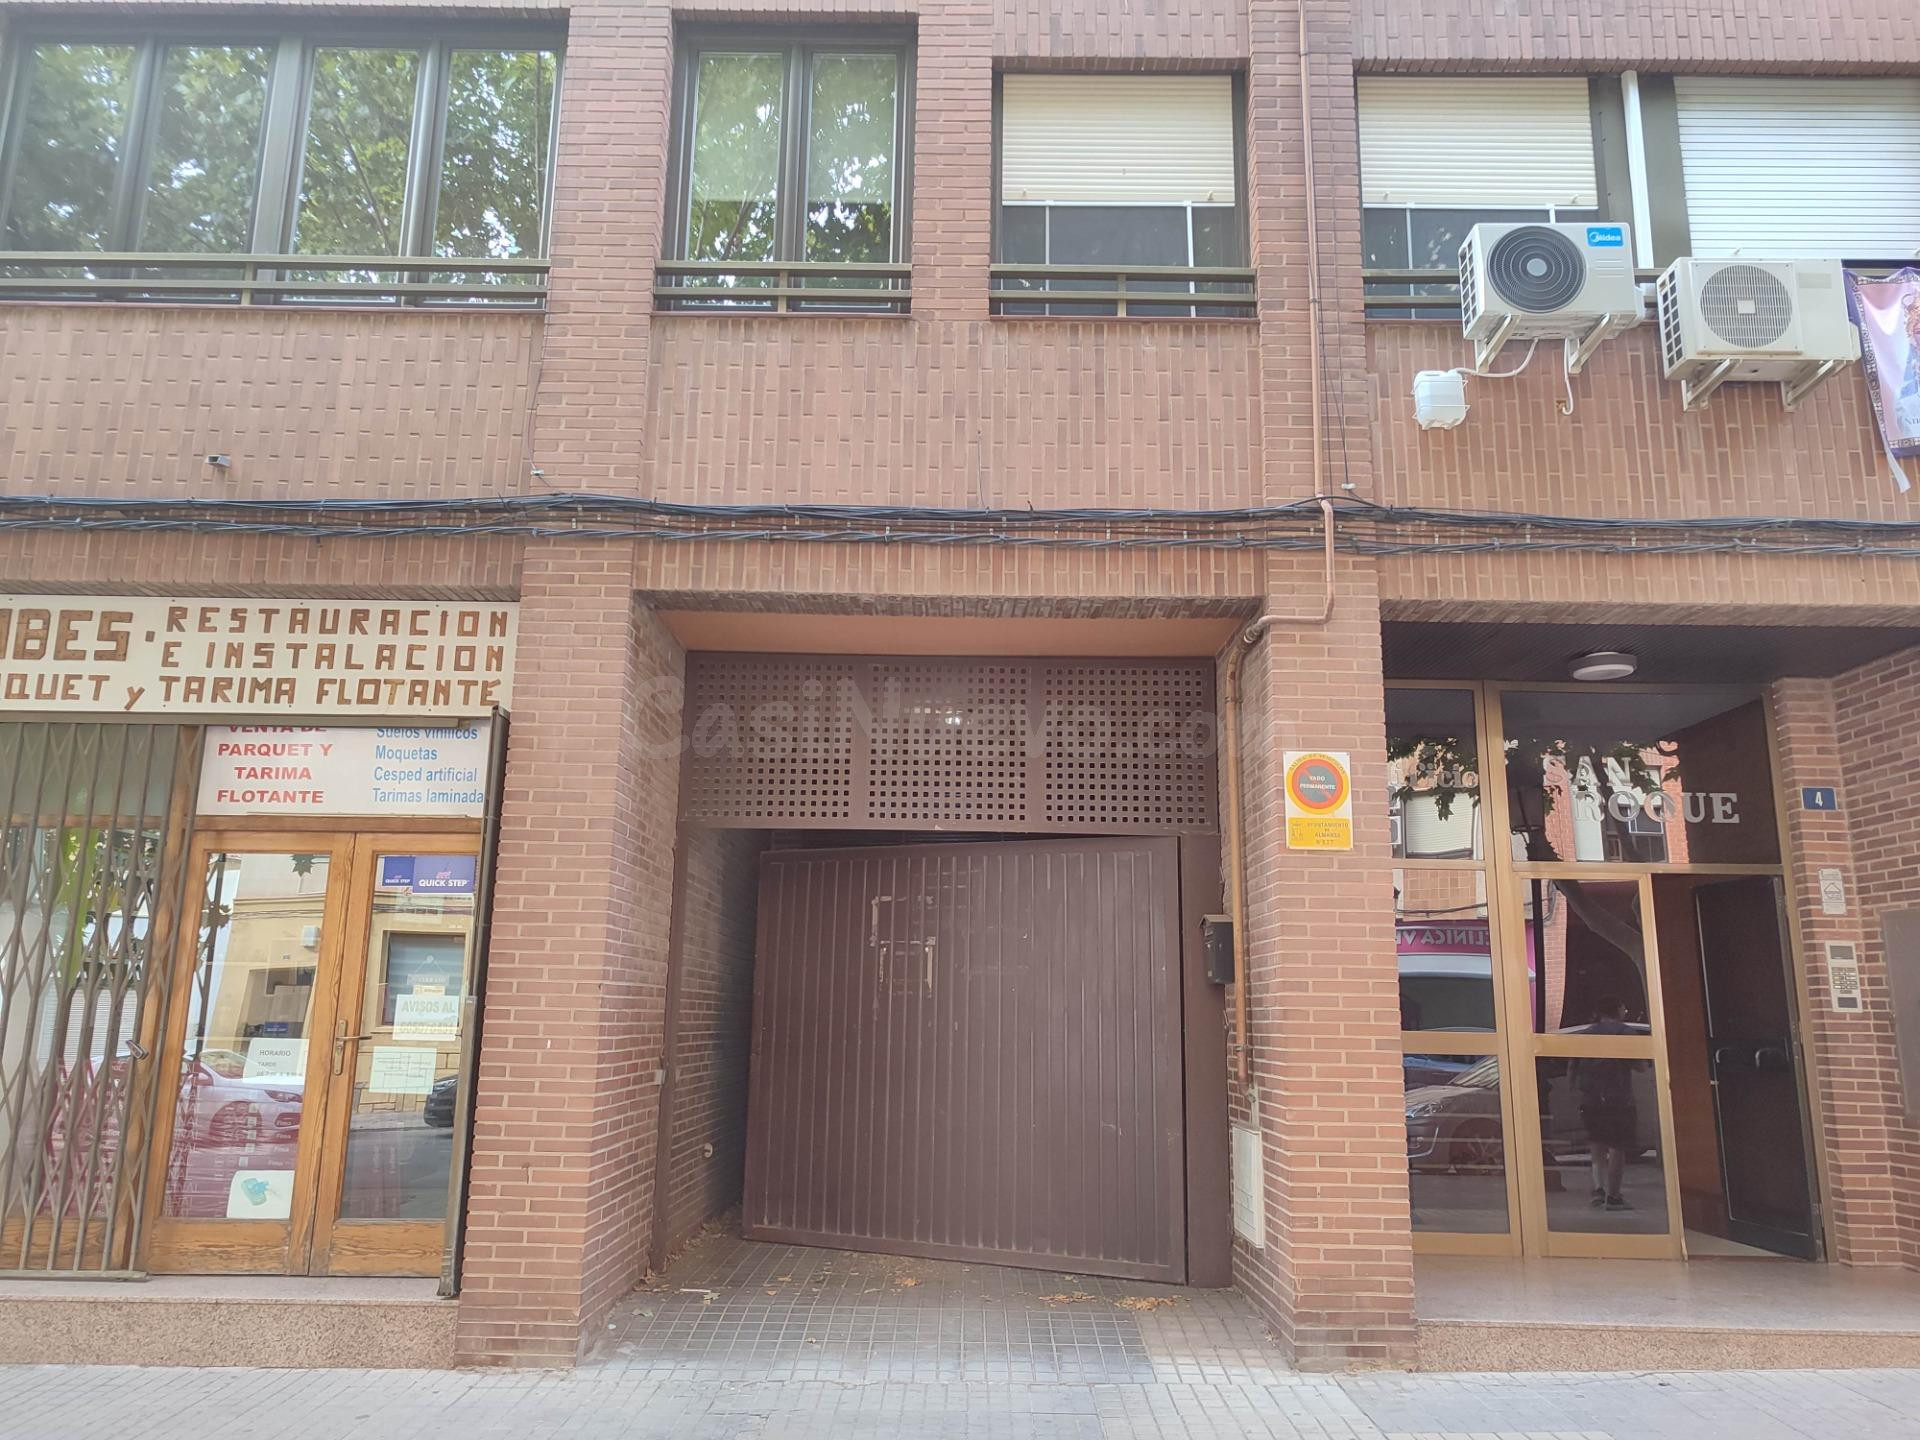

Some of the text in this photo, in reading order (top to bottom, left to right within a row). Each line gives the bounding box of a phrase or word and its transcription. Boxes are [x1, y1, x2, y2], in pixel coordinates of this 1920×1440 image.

[1589, 231, 1621, 243] Midea
[166, 606, 508, 637] RESTAURACION
[161, 641, 504, 672] E INSTALACION
[0, 673, 110, 702] QUET
[159, 675, 296, 704] TARIMA
[316, 678, 502, 707] FLOTANTE
[217, 743, 334, 757] PARQUET Y
[375, 745, 438, 763] Moquetas
[234, 766, 312, 780] TARIMA
[374, 766, 477, 785] Cesped artificial
[1543, 755, 1634, 787] SAN
[216, 789, 325, 804] FLOTANTE
[372, 788, 422, 803] Tarimas
[1815, 791, 1824, 807] 4
[1575, 790, 1741, 824] ROQUE
[401, 1001, 456, 1013] AVISOS AL
[259, 1049, 291, 1057] HORARIO
